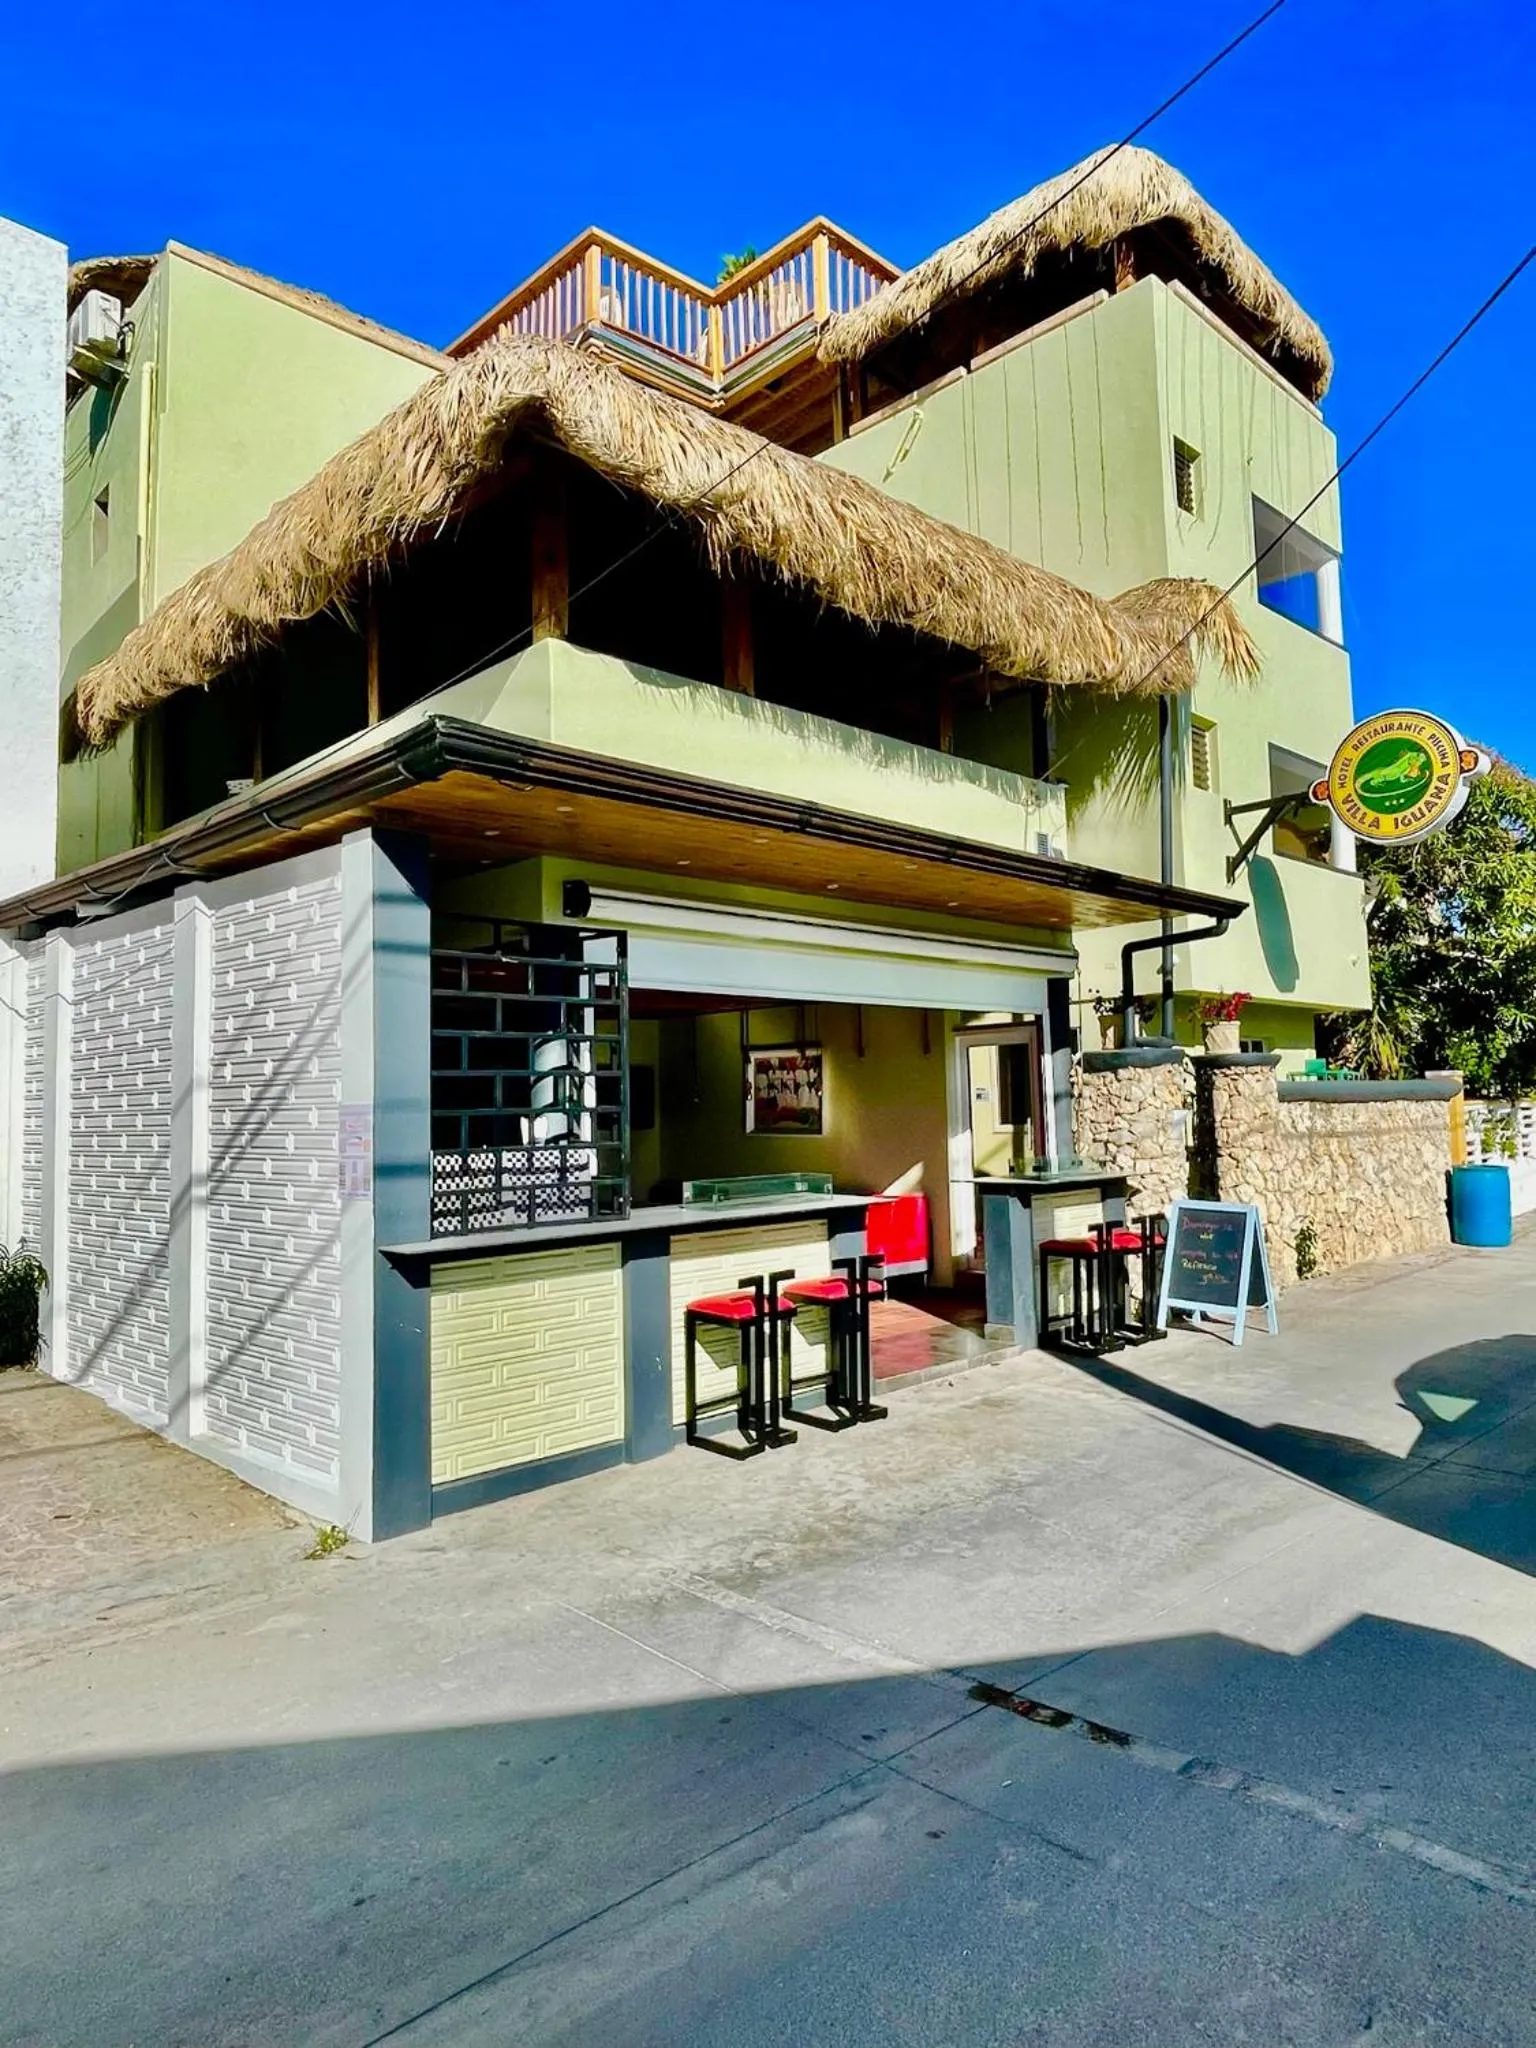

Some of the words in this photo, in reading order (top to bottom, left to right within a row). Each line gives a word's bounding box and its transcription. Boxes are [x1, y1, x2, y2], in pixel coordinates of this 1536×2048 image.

[1339, 757, 1353, 789] HOTEL
[1352, 722, 1426, 752] RESTAURANTE
[1427, 733, 1450, 768] PISCINA
[1342, 793, 1380, 829] VILLA
[1394, 773, 1451, 829] IGUANA
